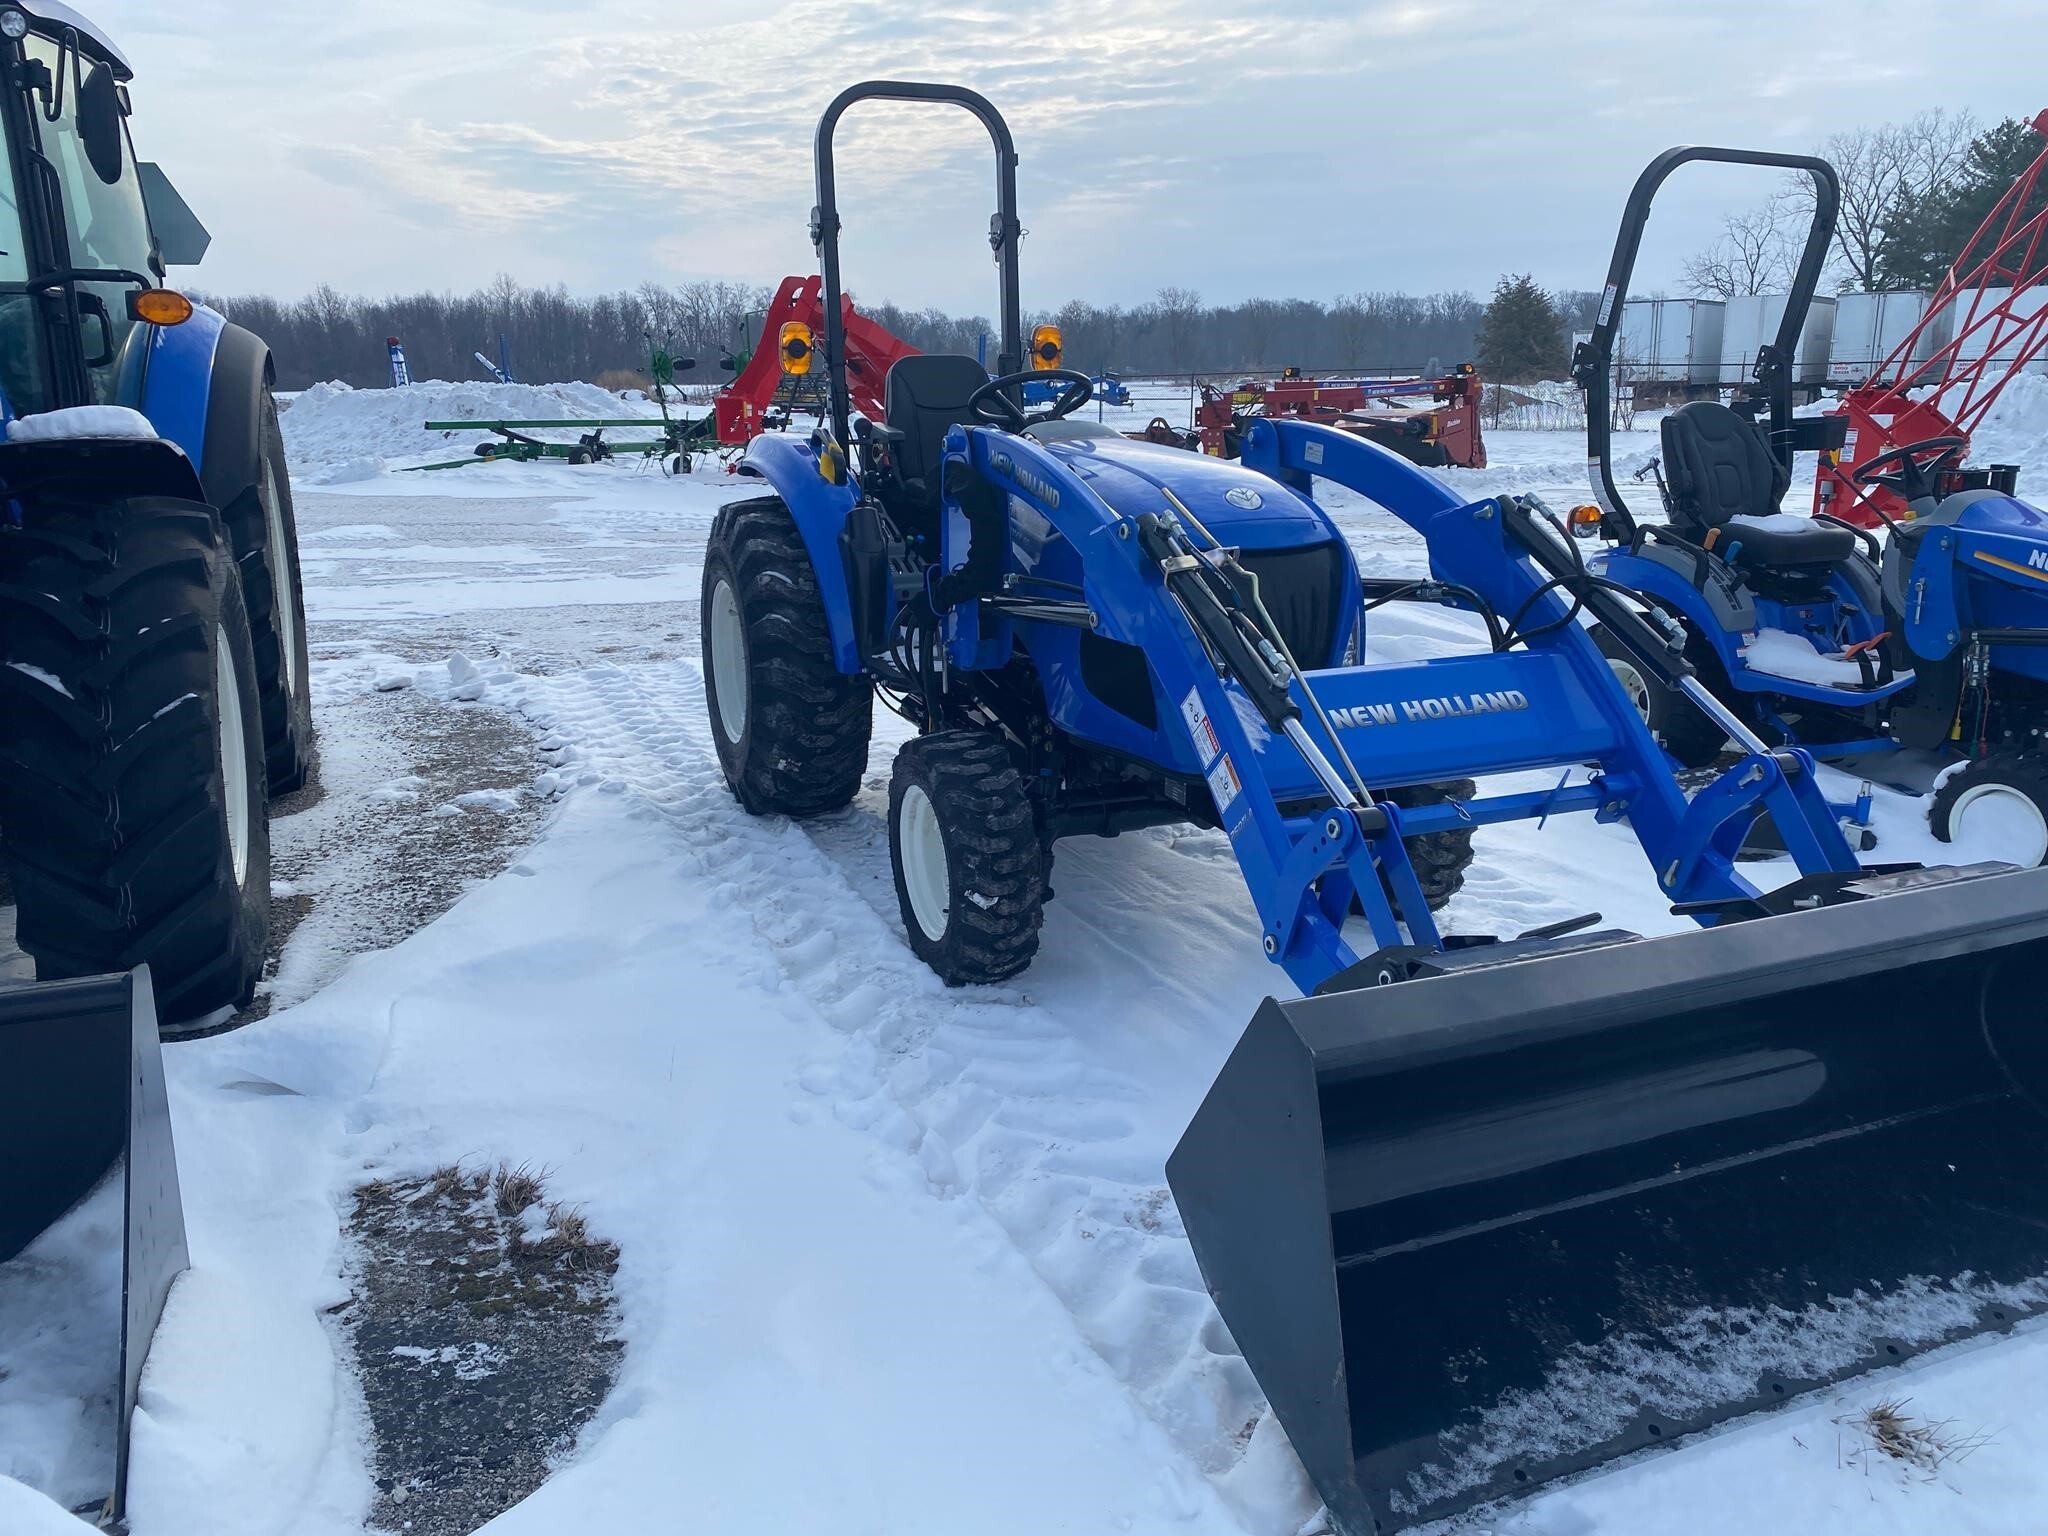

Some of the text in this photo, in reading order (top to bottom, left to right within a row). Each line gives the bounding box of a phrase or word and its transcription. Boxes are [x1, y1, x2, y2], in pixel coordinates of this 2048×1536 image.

[991, 450, 1060, 510] NEW HOLLAND
[2028, 549, 2048, 571] N
[1328, 690, 1529, 730] NEW HOLLAND
